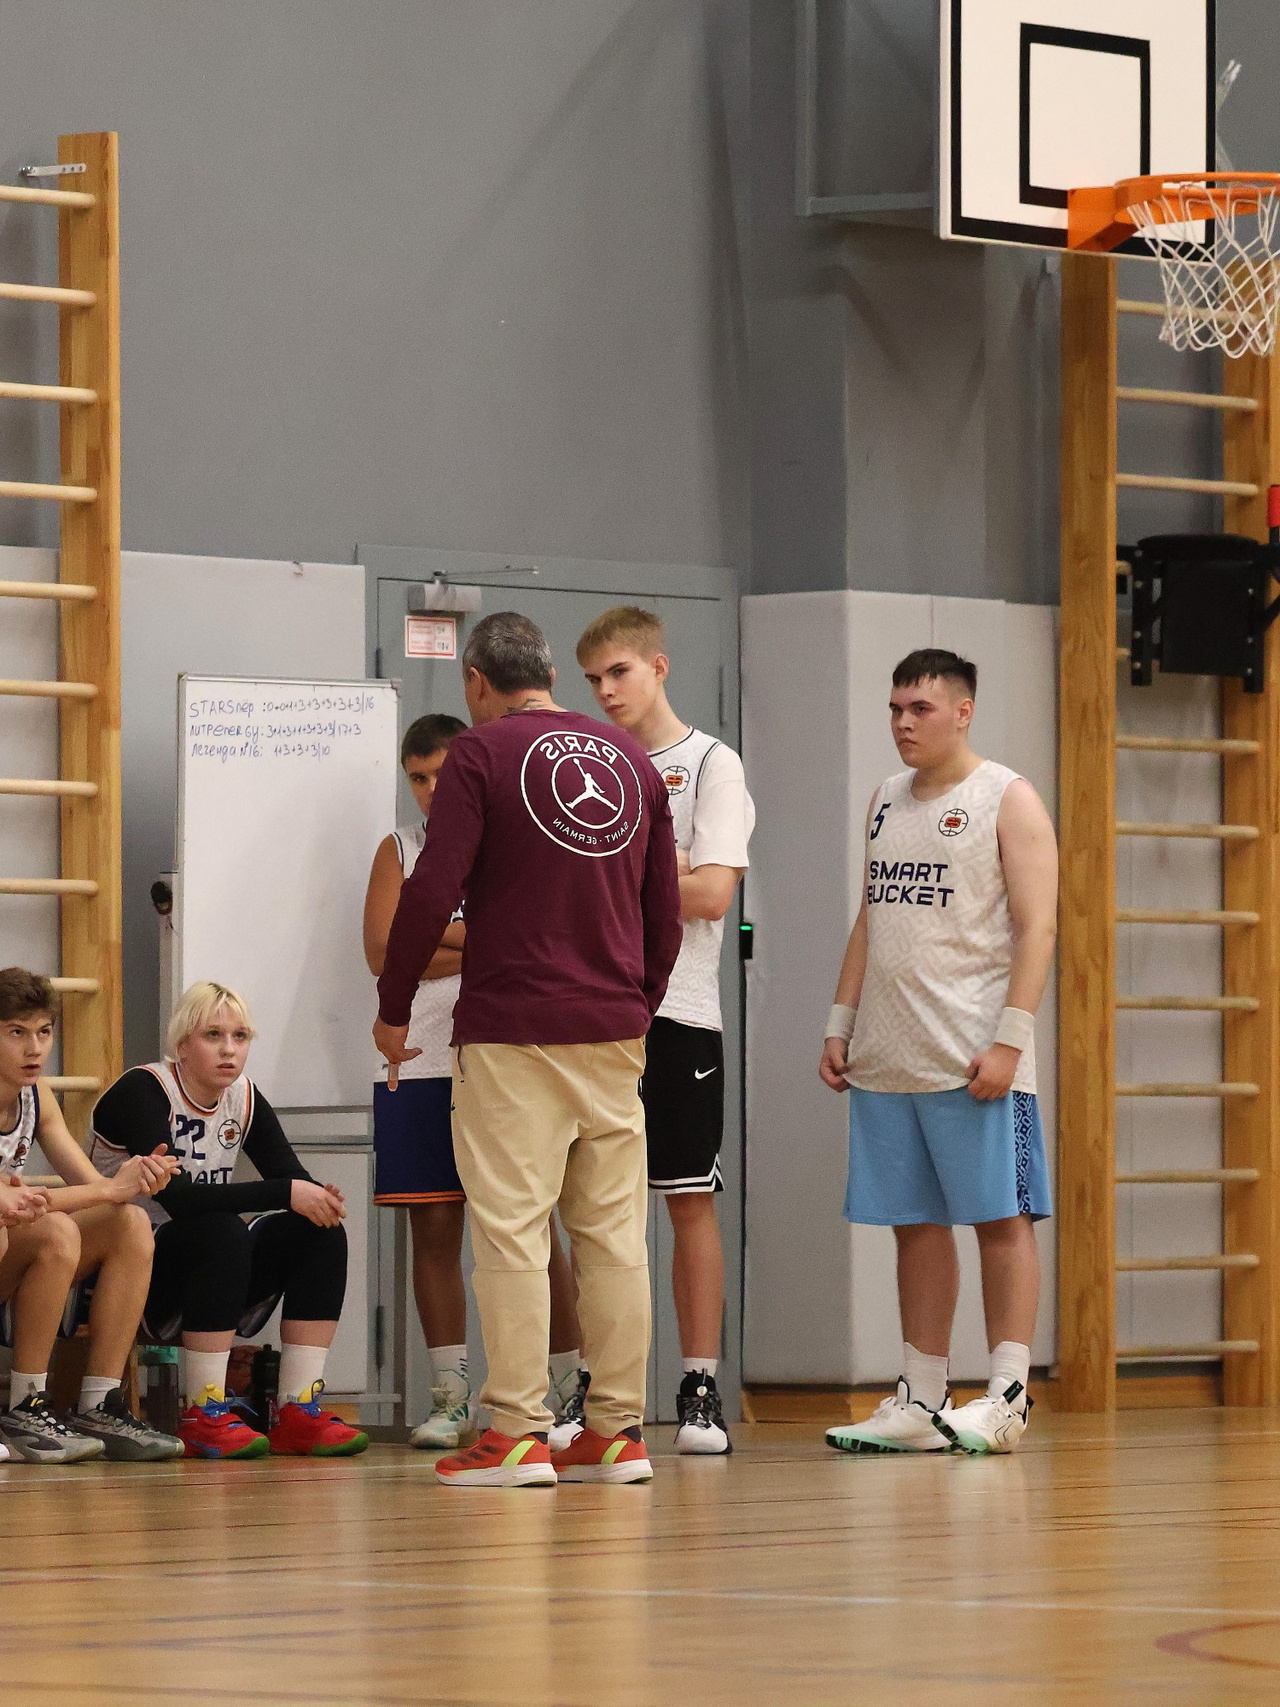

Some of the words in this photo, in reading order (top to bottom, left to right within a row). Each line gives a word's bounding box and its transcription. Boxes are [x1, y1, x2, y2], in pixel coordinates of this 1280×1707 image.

[870, 802, 892, 841] 5
[870, 860, 949, 883] SMART
[174, 1113, 206, 1160] 22
